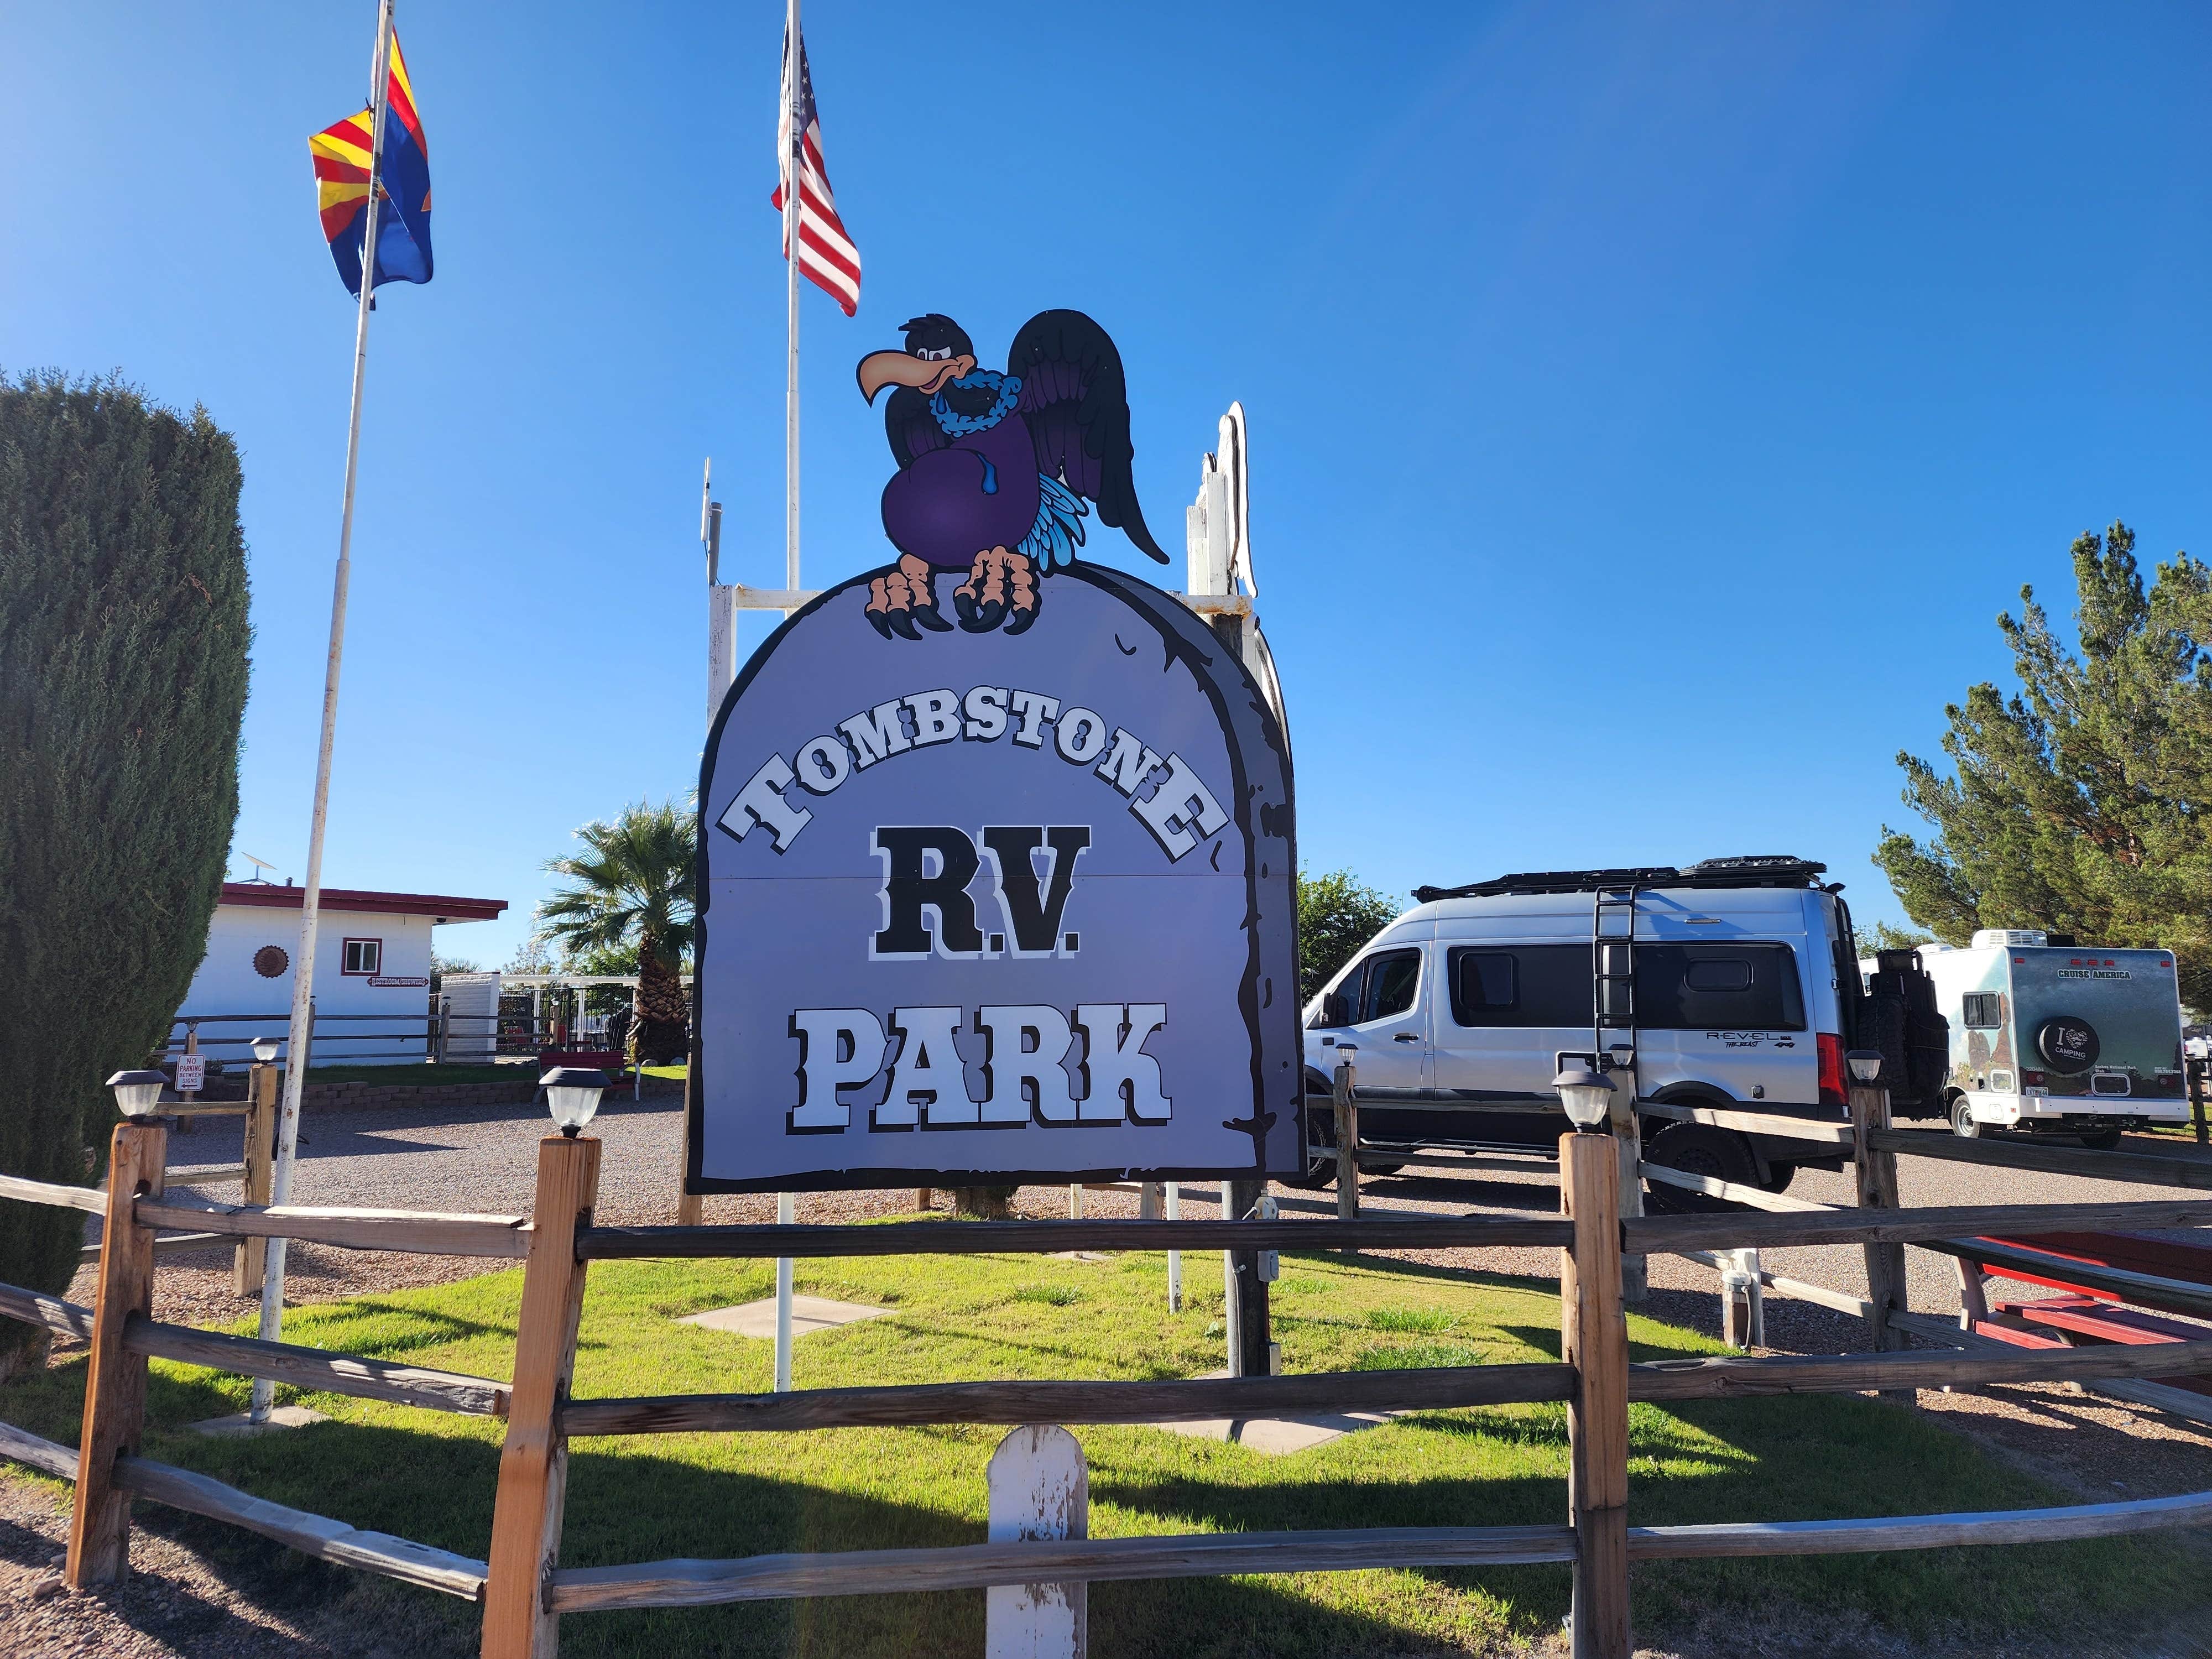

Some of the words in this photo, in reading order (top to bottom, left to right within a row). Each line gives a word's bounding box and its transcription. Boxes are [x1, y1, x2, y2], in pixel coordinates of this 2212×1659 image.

[715, 685, 1230, 863] TOMBSTONE
[869, 825, 1092, 962] R.V.
[2058, 969, 2090, 979] CRUISE
[2092, 970, 2132, 980] AMERICA
[1707, 1032, 1780, 1040] REVEL
[2057, 1027, 2065, 1046] I
[2055, 1047, 2086, 1058] CAMPING
[785, 1003, 1172, 1135] PARK
